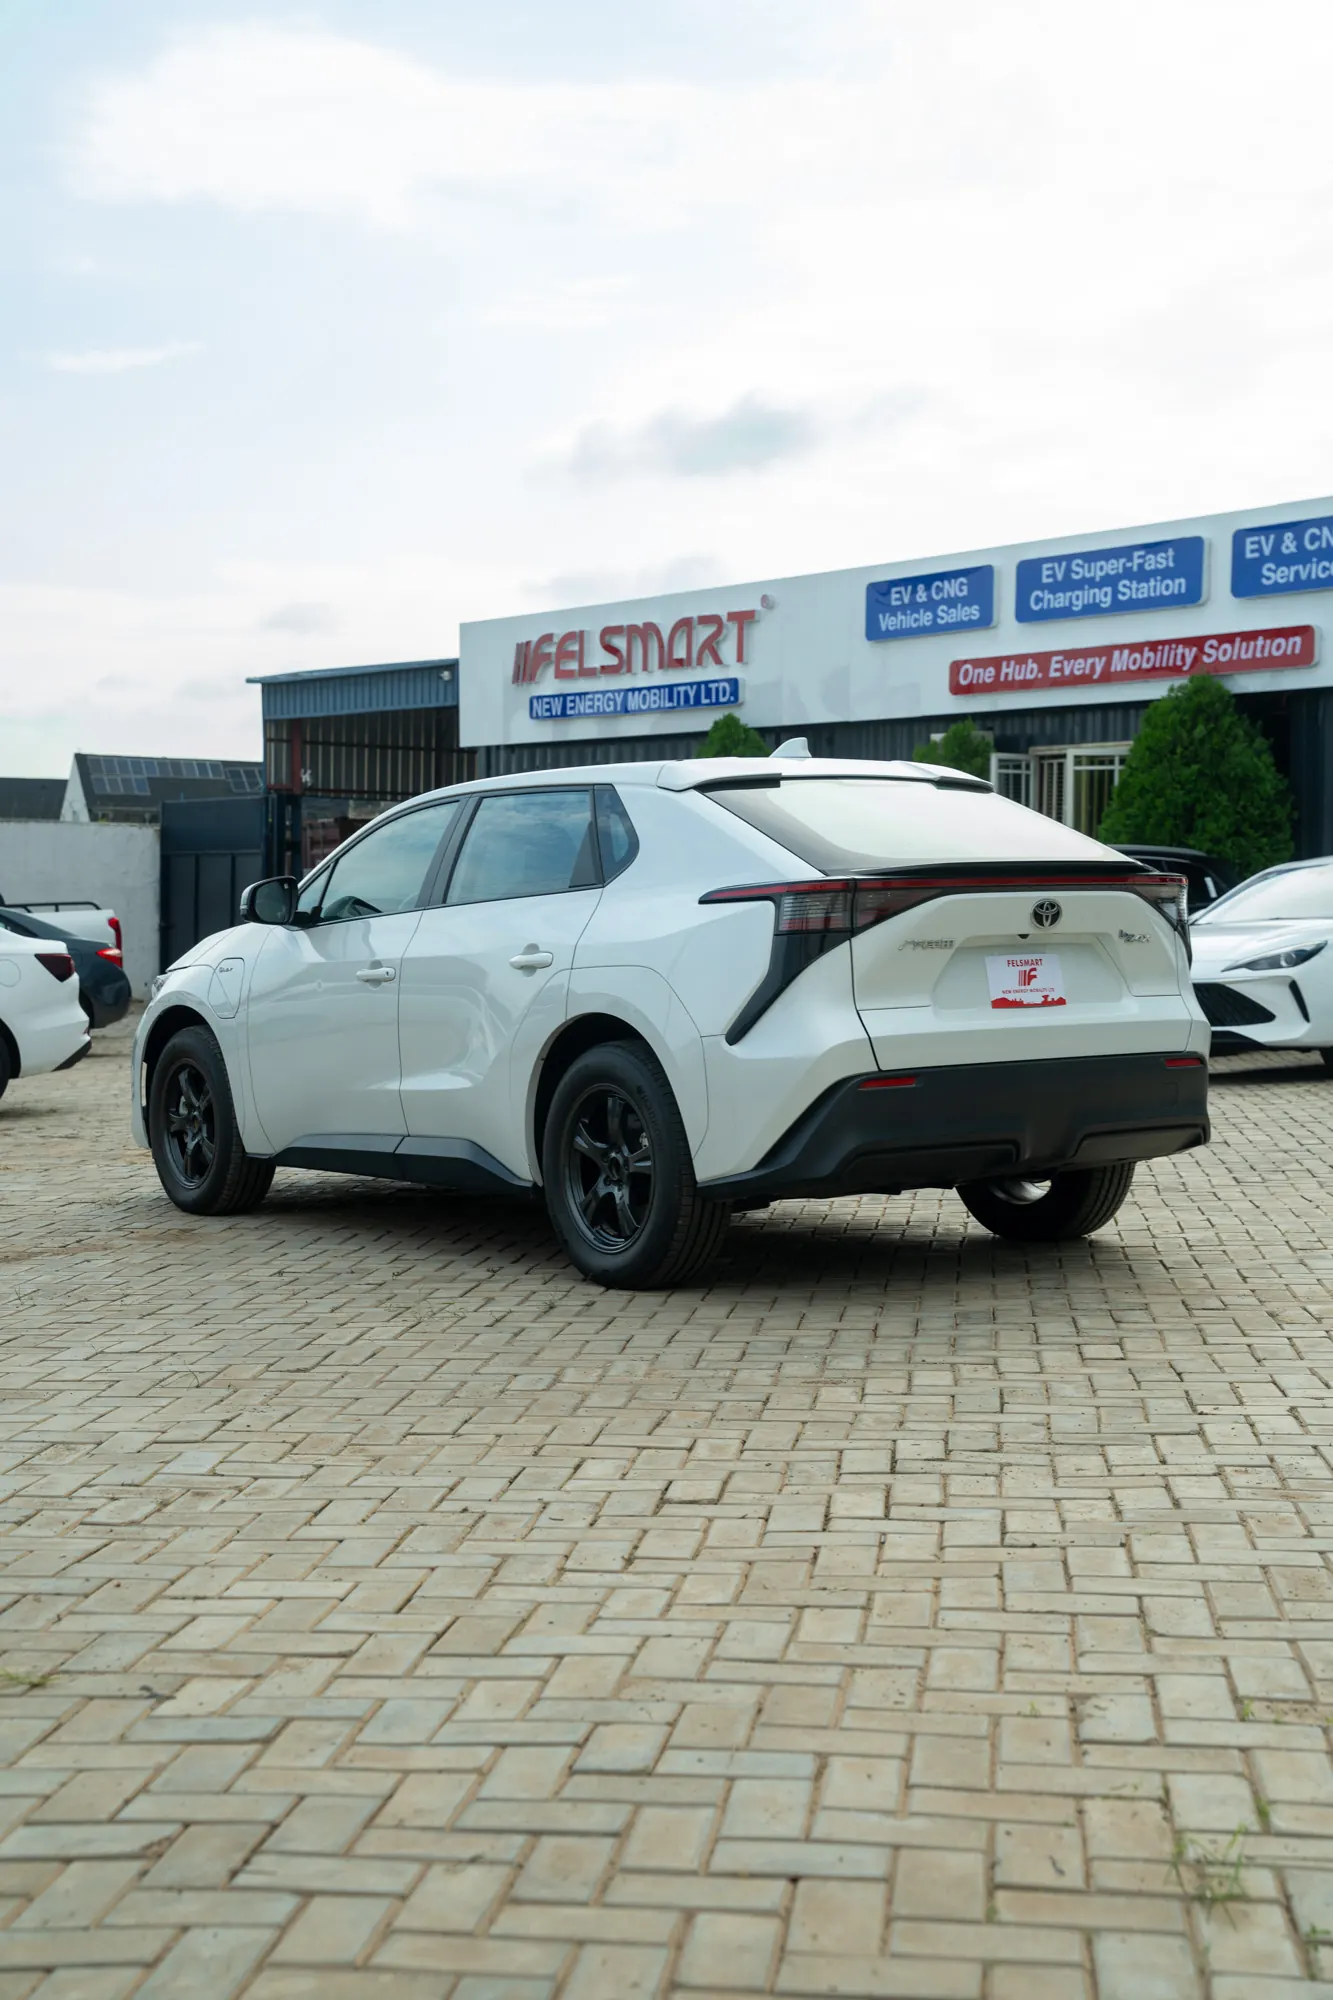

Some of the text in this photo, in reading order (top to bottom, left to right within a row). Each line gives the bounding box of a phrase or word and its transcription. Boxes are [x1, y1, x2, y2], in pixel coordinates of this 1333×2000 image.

[1245, 534, 1275, 559] EV
[1281, 532, 1298, 554] &
[1041, 548, 1175, 583] EV Super-Fast
[1261, 557, 1333, 586] Servic
[890, 577, 968, 606] EV & CNG
[1030, 576, 1187, 611] Charging Station
[878, 603, 980, 632] Vehicle Sales
[530, 610, 756, 682] FELSMART
[958, 635, 1302, 686] One Hub. Every Mobility Solution
[531, 697, 563, 718] NEW
[566, 690, 625, 715] ENERGY
[627, 684, 697, 711] MOBILITY
[1007, 958, 1043, 967] FELSMART
